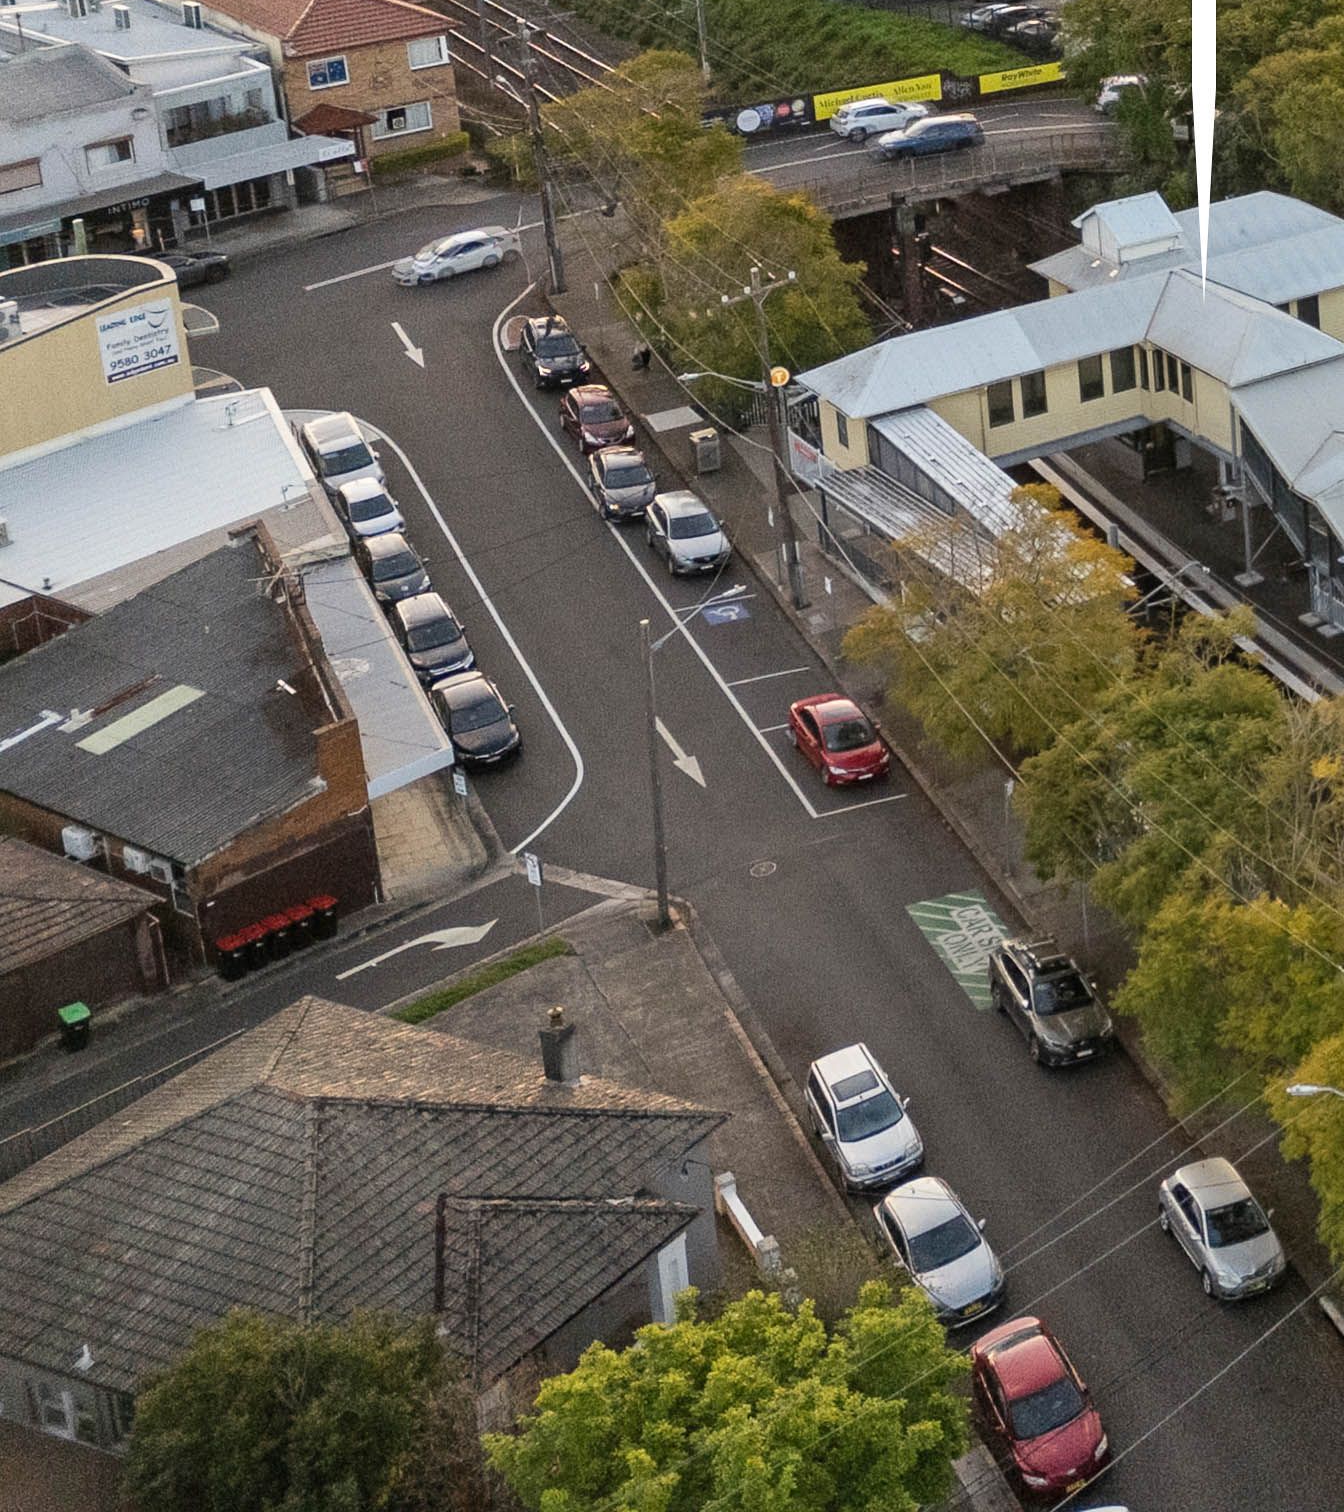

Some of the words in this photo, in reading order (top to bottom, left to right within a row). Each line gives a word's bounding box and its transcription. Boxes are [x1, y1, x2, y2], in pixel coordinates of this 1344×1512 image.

[107, 198, 150, 215] INTIMO
[99, 319, 127, 333] LEADING
[129, 312, 146, 324] EDGE
[106, 338, 131, 351] Family
[134, 328, 169, 344] Dentistry
[110, 354, 140, 371] 9580
[143, 344, 172, 361] 3047
[957, 908, 992, 937] CAR
